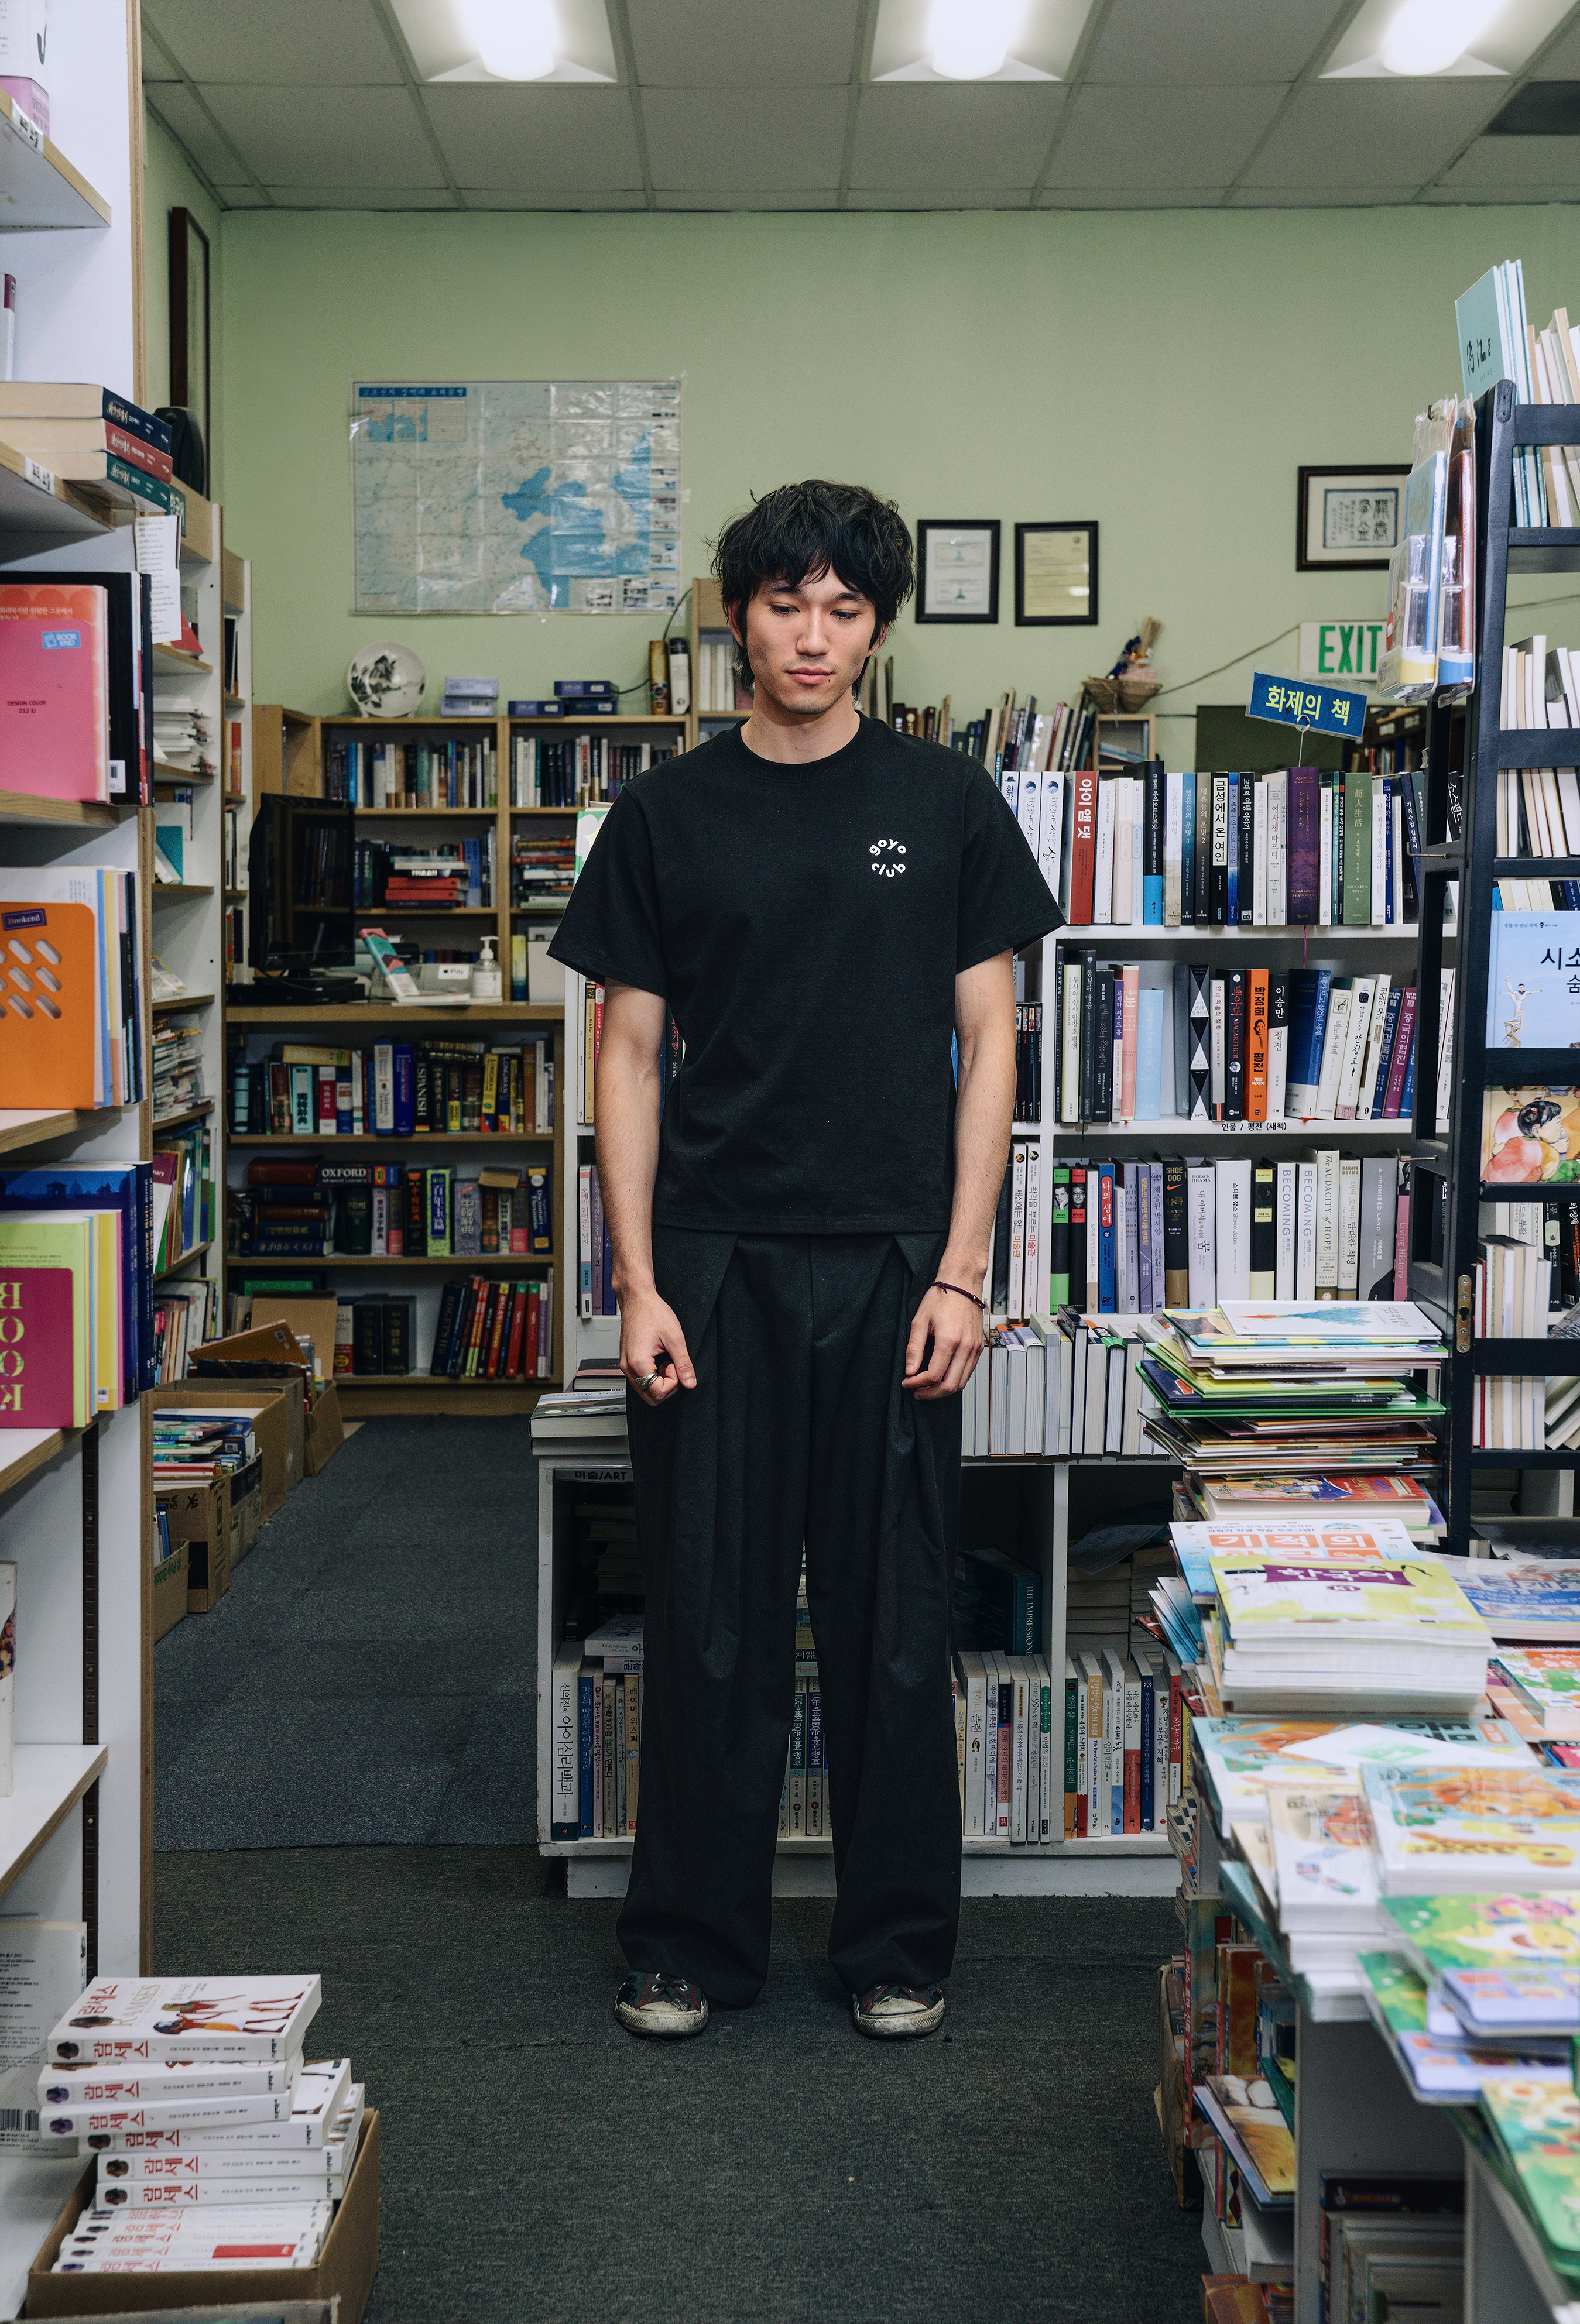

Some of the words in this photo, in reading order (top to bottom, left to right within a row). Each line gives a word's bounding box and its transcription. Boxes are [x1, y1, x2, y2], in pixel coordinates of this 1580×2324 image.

[1319, 625, 1383, 674] EXIT
[1265, 685, 1322, 720] 화제의
[1331, 698, 1351, 726] 책
[1078, 778, 1092, 805] 아이
[1242, 778, 1252, 796] 고대의
[1215, 781, 1226, 823] 금성에서
[1242, 797, 1252, 811] 여행
[1354, 788, 1363, 827] 超人生活
[1448, 782, 1462, 824] 소스필드
[1078, 809, 1092, 822] 앰
[1242, 812, 1252, 830] 이야기
[1406, 801, 1415, 828] 기적수업
[1078, 826, 1092, 839] 댓
[1215, 827, 1226, 837] 온
[869, 838, 907, 856] goyo
[1215, 841, 1226, 862] 여인
[870, 862, 906, 878] club
[8, 914, 40, 925] Bookend
[1123, 995, 1136, 1008] 눈
[1215, 986, 1222, 998] 앤디
[1231, 986, 1242, 1017] 맥아더
[1254, 986, 1266, 1016] 박정희
[1071, 998, 1079, 1012] 신사
[1274, 986, 1285, 1019] 이승만
[1215, 1019, 1222, 1031] 철학
[1332, 1021, 1341, 1042] 비노바
[1071, 1036, 1079, 1050] 평전
[1274, 1029, 1283, 1052] 평전
[1330, 1042, 1338, 1055] 바베
[1253, 1052, 1264, 1073] 평전
[417, 1067, 427, 1117] SPANISH
[1222, 1122, 1236, 1131] 인물
[1240, 1122, 1244, 1131] /
[1247, 1122, 1262, 1131] 평전
[1266, 1122, 1287, 1131] (새책)
[321, 1168, 367, 1178] OXFORD
[1028, 1186, 1037, 1209] 착각을
[1102, 1180, 1111, 1202] 나의
[1153, 1185, 1161, 1210] 제중원
[1349, 1181, 1356, 1196] 버락
[1013, 1188, 1023, 1218] 세상에는
[1233, 1200, 1239, 1212] 잡스
[1282, 1170, 1291, 1236] BECOMING
[1303, 1170, 1312, 1237] BECOMING
[1348, 1198, 1356, 1220] 오바마
[1028, 1210, 1037, 1233] 부르는
[1102, 1204, 1111, 1224] 생애
[1153, 1211, 1161, 1237] 박서양
[1198, 1200, 1206, 1239] 아버지로부터의
[1322, 1216, 1331, 1224] of
[1013, 1218, 1023, 1235] 없는
[1347, 1221, 1356, 1247] 담대한
[1399, 1222, 1407, 1247] Living
[1013, 1235, 1023, 1258] 미술관
[1028, 1234, 1037, 1257] 미술관
[1198, 1241, 1210, 1252] 꿈
[1346, 1248, 1356, 1266] 희망
[1396, 1248, 1406, 1279] History
[574, 1470, 627, 1481] 미술/ART
[1277, 1567, 1396, 1581] 한국어
[560, 1682, 571, 1713] 신의진의
[971, 1685, 982, 1712] 베이비
[1090, 1677, 1100, 1702] 긍정적인
[1126, 1690, 1132, 1701] 나를
[1133, 1690, 1139, 1701] 나는
[605, 1703, 613, 1717] 수학
[629, 1688, 638, 1713] 베이비
[1090, 1702, 1100, 1722] 엄마의
[605, 1718, 613, 1738] 100점
[629, 1717, 638, 1742] 위스퍼
[971, 1714, 982, 1733] 플랜
[1090, 1723, 1100, 1735] 파워
[557, 1715, 574, 1798] 아이심리백과
[605, 1738, 613, 1757] 엄마가
[605, 1759, 613, 1779] 만든다
[1042, 1756, 1049, 1768] 코칭
[1001, 1789, 1008, 1801] 방법
[78, 1983, 119, 2014] 람세스
[94, 2040, 149, 2058] 람세스
[84, 2080, 139, 2100] 람세스
[88, 2109, 145, 2131] 람세스
[125, 2129, 180, 2149] 람세스
[144, 2155, 199, 2176] 람세스
[143, 2182, 198, 2203] 람세스
